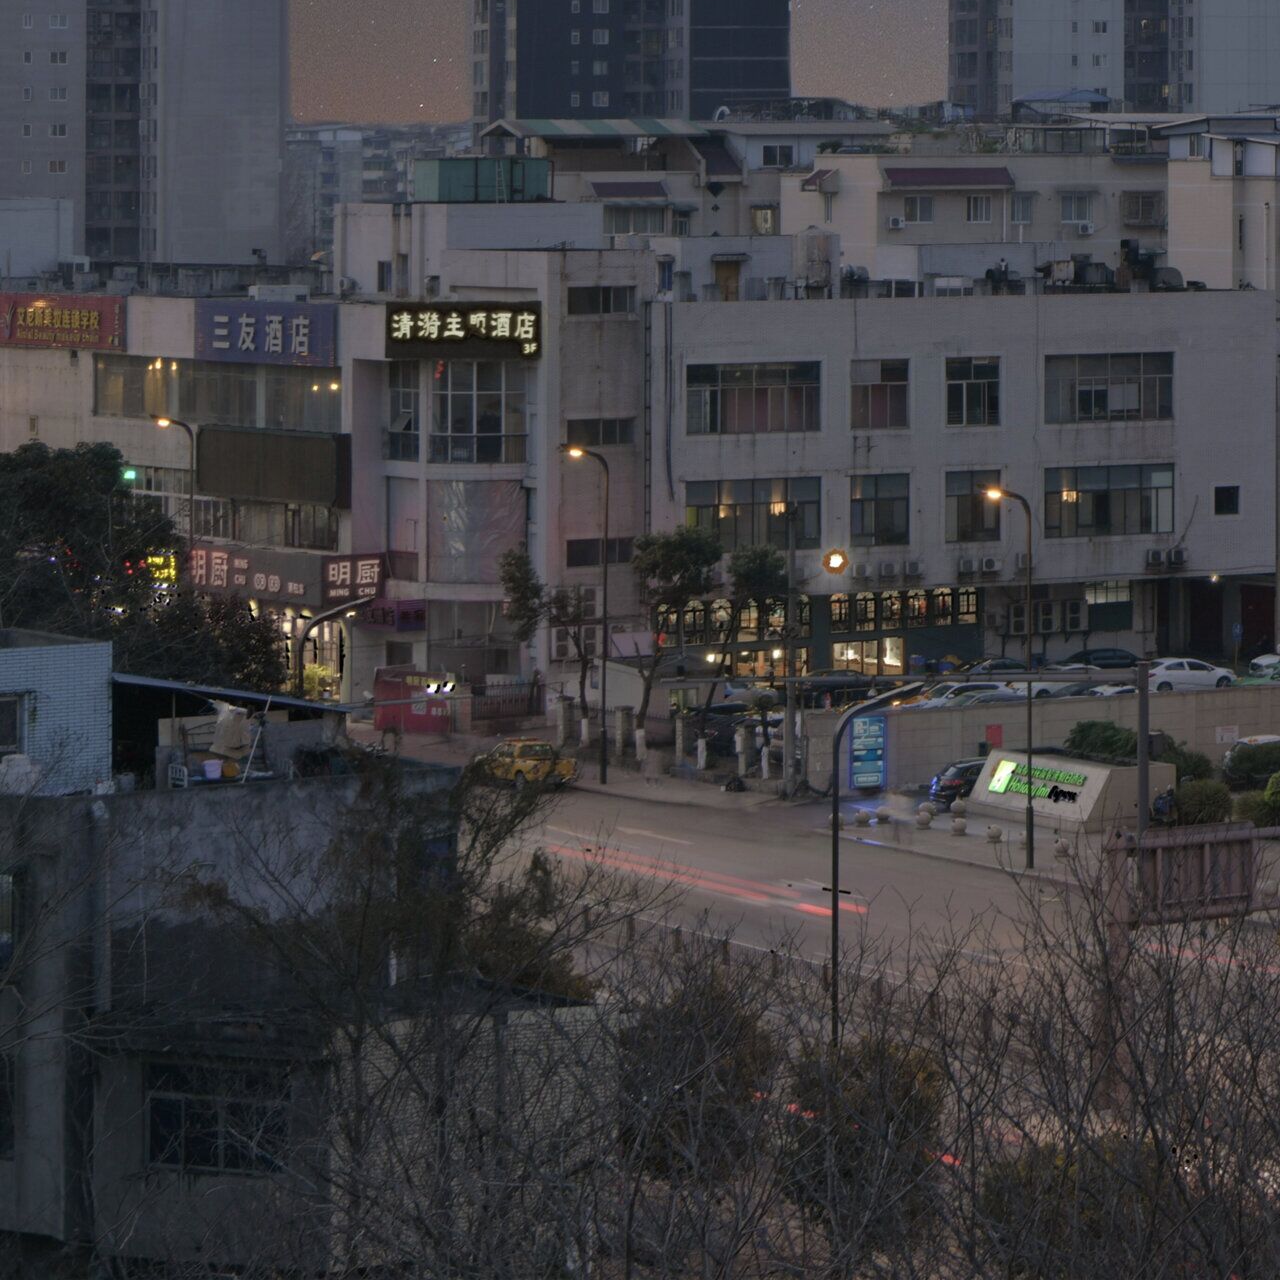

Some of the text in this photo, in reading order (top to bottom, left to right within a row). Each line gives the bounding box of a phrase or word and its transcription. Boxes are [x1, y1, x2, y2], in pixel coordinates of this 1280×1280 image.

[212, 313, 310, 354] 三友酒店
[522, 342, 538, 354] 3F
[328, 559, 381, 586] 明厨
[329, 586, 377, 598] MING CHU
